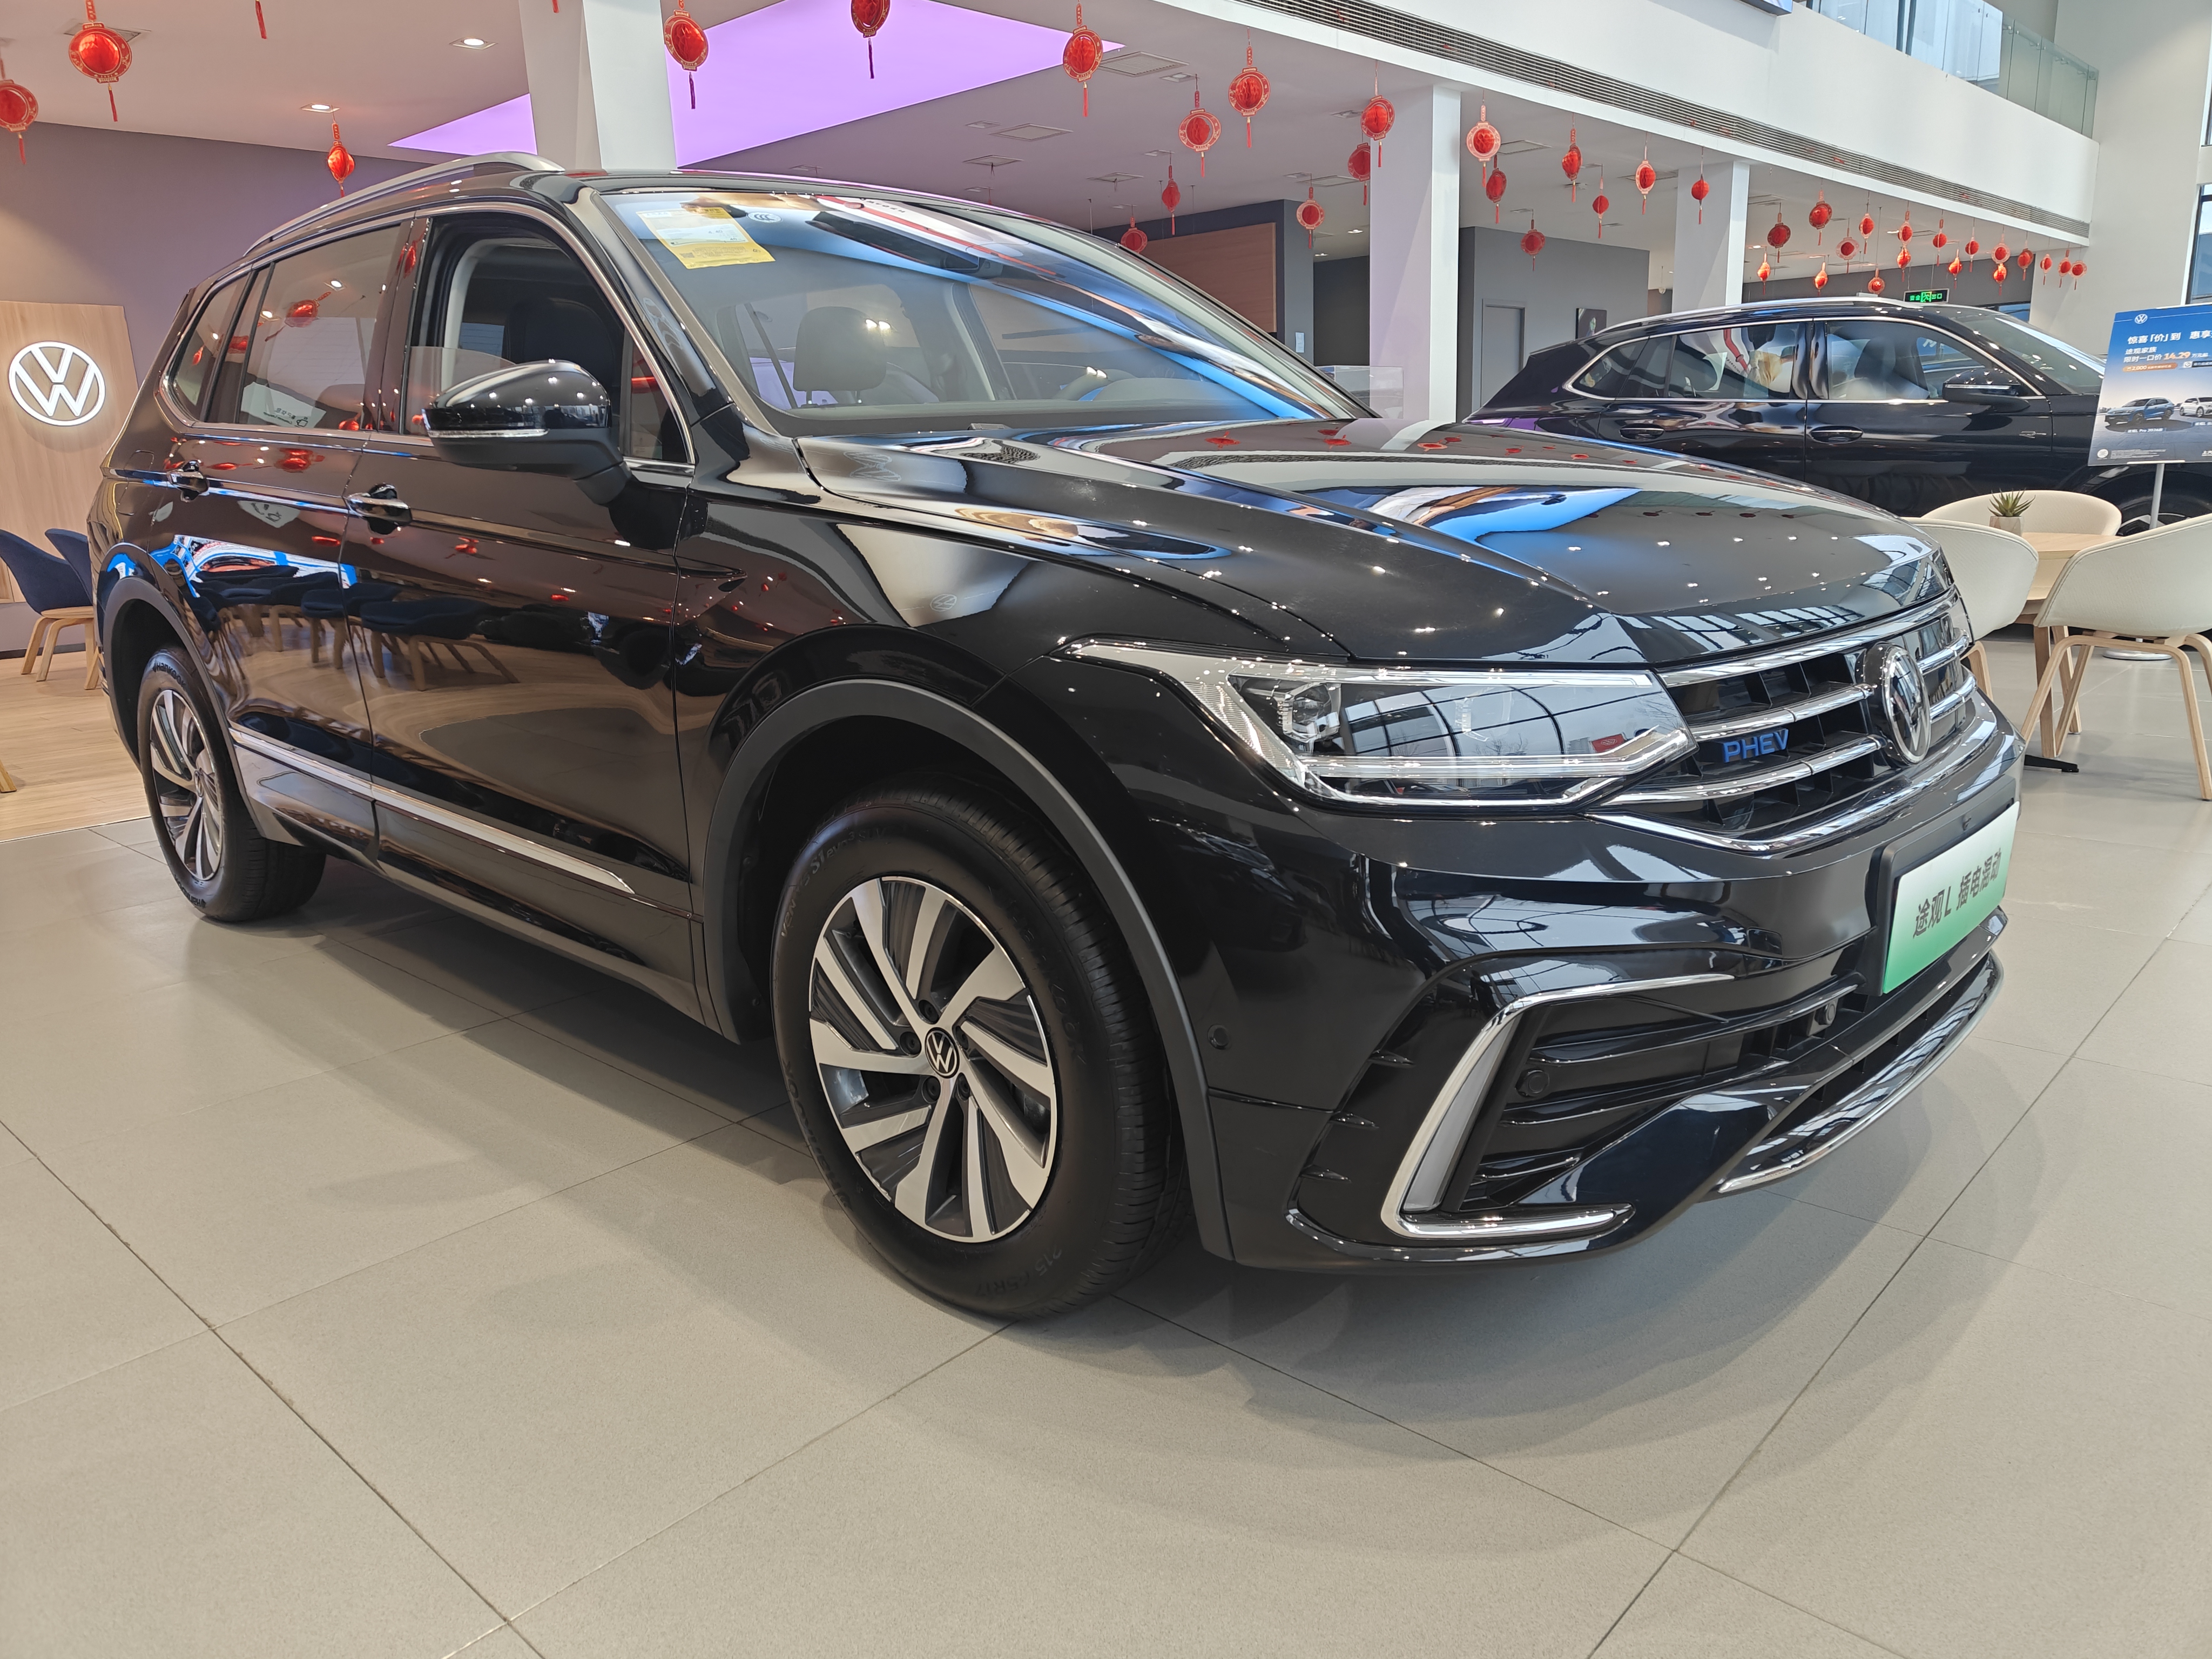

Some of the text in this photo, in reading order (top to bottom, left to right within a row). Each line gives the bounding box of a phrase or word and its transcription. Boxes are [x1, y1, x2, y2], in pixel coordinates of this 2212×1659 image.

[2127, 330, 2212, 345] 惊喜「价」到 惠享
[2123, 354, 2162, 363] 限时一口价
[2163, 352, 2191, 360] 14.29
[1723, 729, 1789, 763] PHEV
[1913, 847, 2002, 939] 途观L 插电混动
